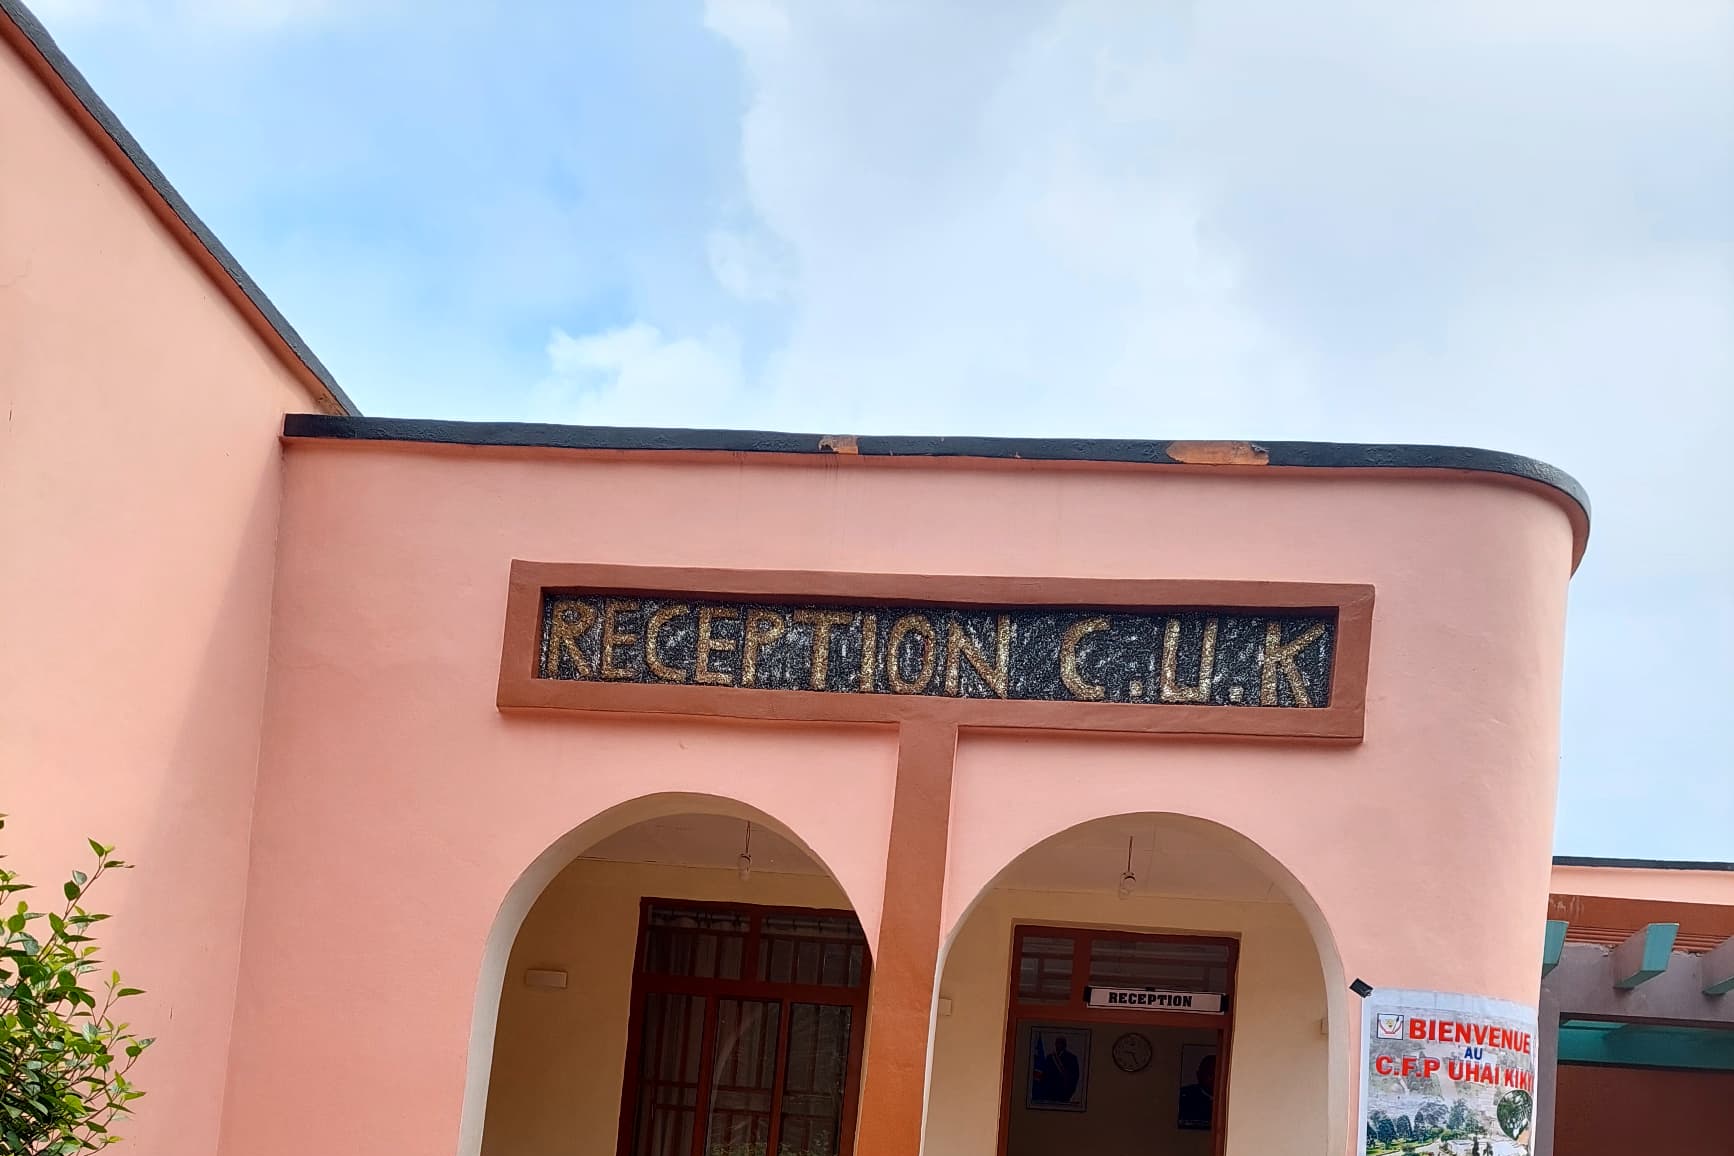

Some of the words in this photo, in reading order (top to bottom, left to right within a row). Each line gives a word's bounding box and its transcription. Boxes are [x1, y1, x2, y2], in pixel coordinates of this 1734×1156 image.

[546, 599, 1009, 699] RECEPTION
[1060, 616, 1324, 707] C.U.K
[1108, 991, 1193, 1008] RECEPTION
[1408, 1018, 1531, 1054] BIENVENUE
[1464, 1047, 1483, 1060] AU
[1375, 1055, 1441, 1078] C.F.P
[1449, 1061, 1499, 1085] UHAI
